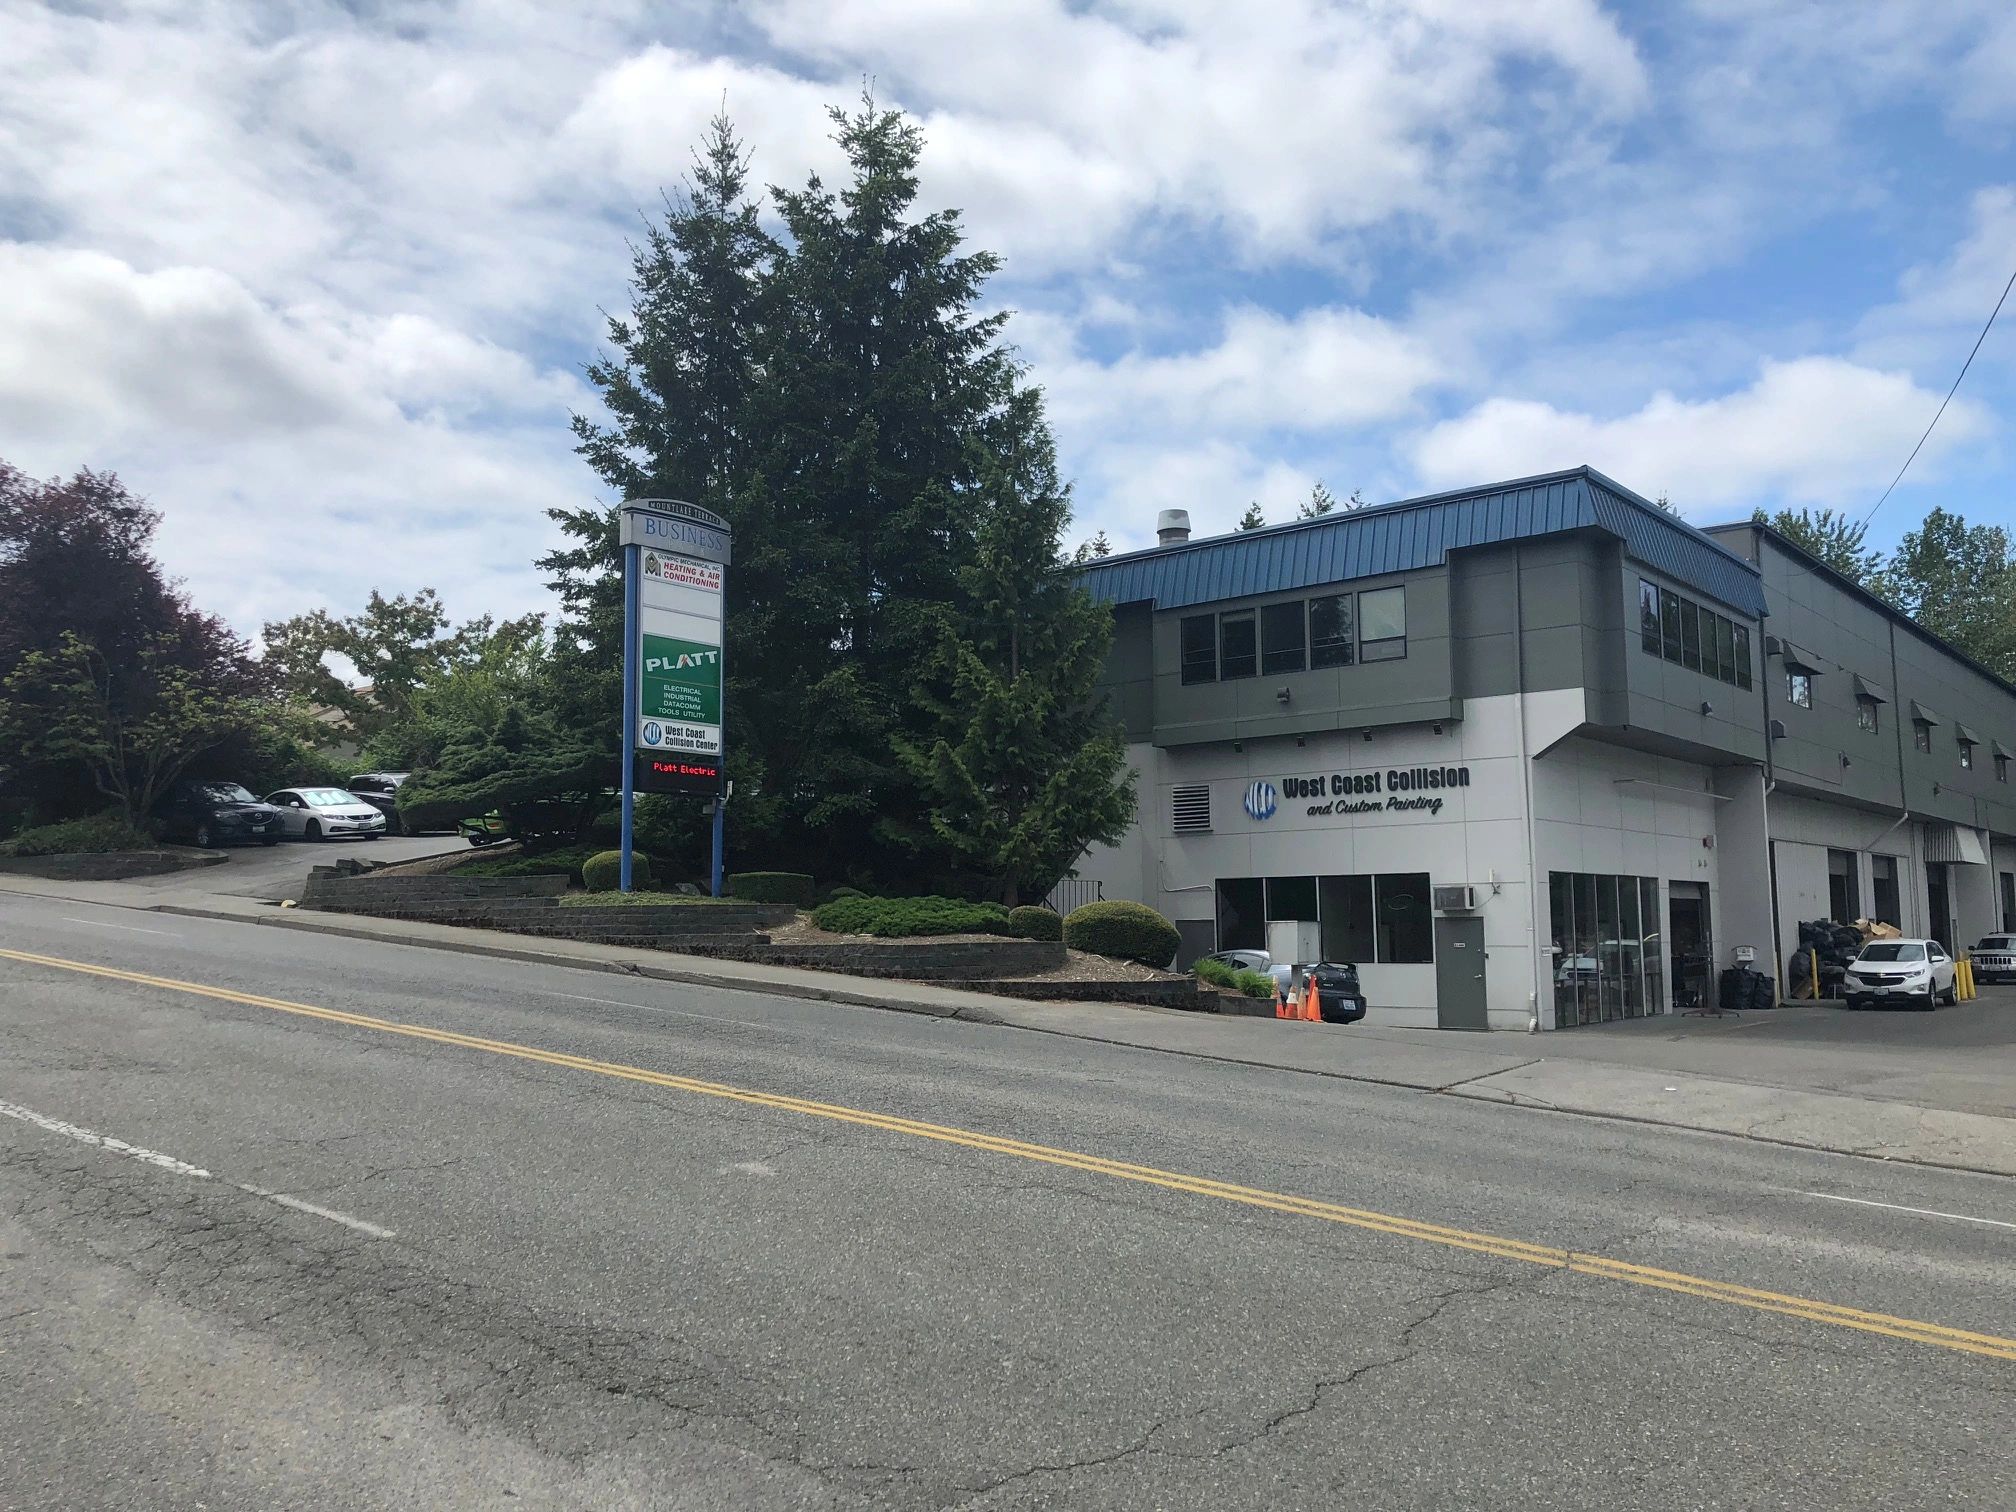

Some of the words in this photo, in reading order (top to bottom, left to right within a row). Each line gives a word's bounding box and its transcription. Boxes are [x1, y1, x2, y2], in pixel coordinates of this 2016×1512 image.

[650, 502, 691, 516] MOUNTLAKE
[694, 509, 720, 524] TERRACE
[645, 517, 723, 551] BUSINESS
[657, 554, 679, 564] OLYMPIC
[663, 562, 697, 575] HEATING
[700, 569, 705, 577] &
[707, 571, 720, 580] AIR
[663, 571, 719, 589] CONDITIONING
[645, 650, 718, 672] PLATT
[663, 684, 702, 695] ELECTRICAL
[663, 692, 701, 703] INDUSTRIAL
[664, 700, 701, 710] DATACOMM
[658, 708, 680, 716] TOOLS
[683, 711, 706, 719] UTILITY
[665, 725, 683, 737] West
[685, 728, 706, 739] Coast
[665, 736, 694, 748] Collision
[695, 739, 718, 750] Center
[653, 762, 677, 773] Platt
[680, 765, 716, 776] Electric
[1282, 775, 1326, 799] West
[1331, 771, 1381, 795] Coast
[1387, 766, 1470, 790] Collision
[1307, 800, 1333, 817] and
[1335, 799, 1383, 814] Custom
[1385, 796, 1443, 816] Painting
